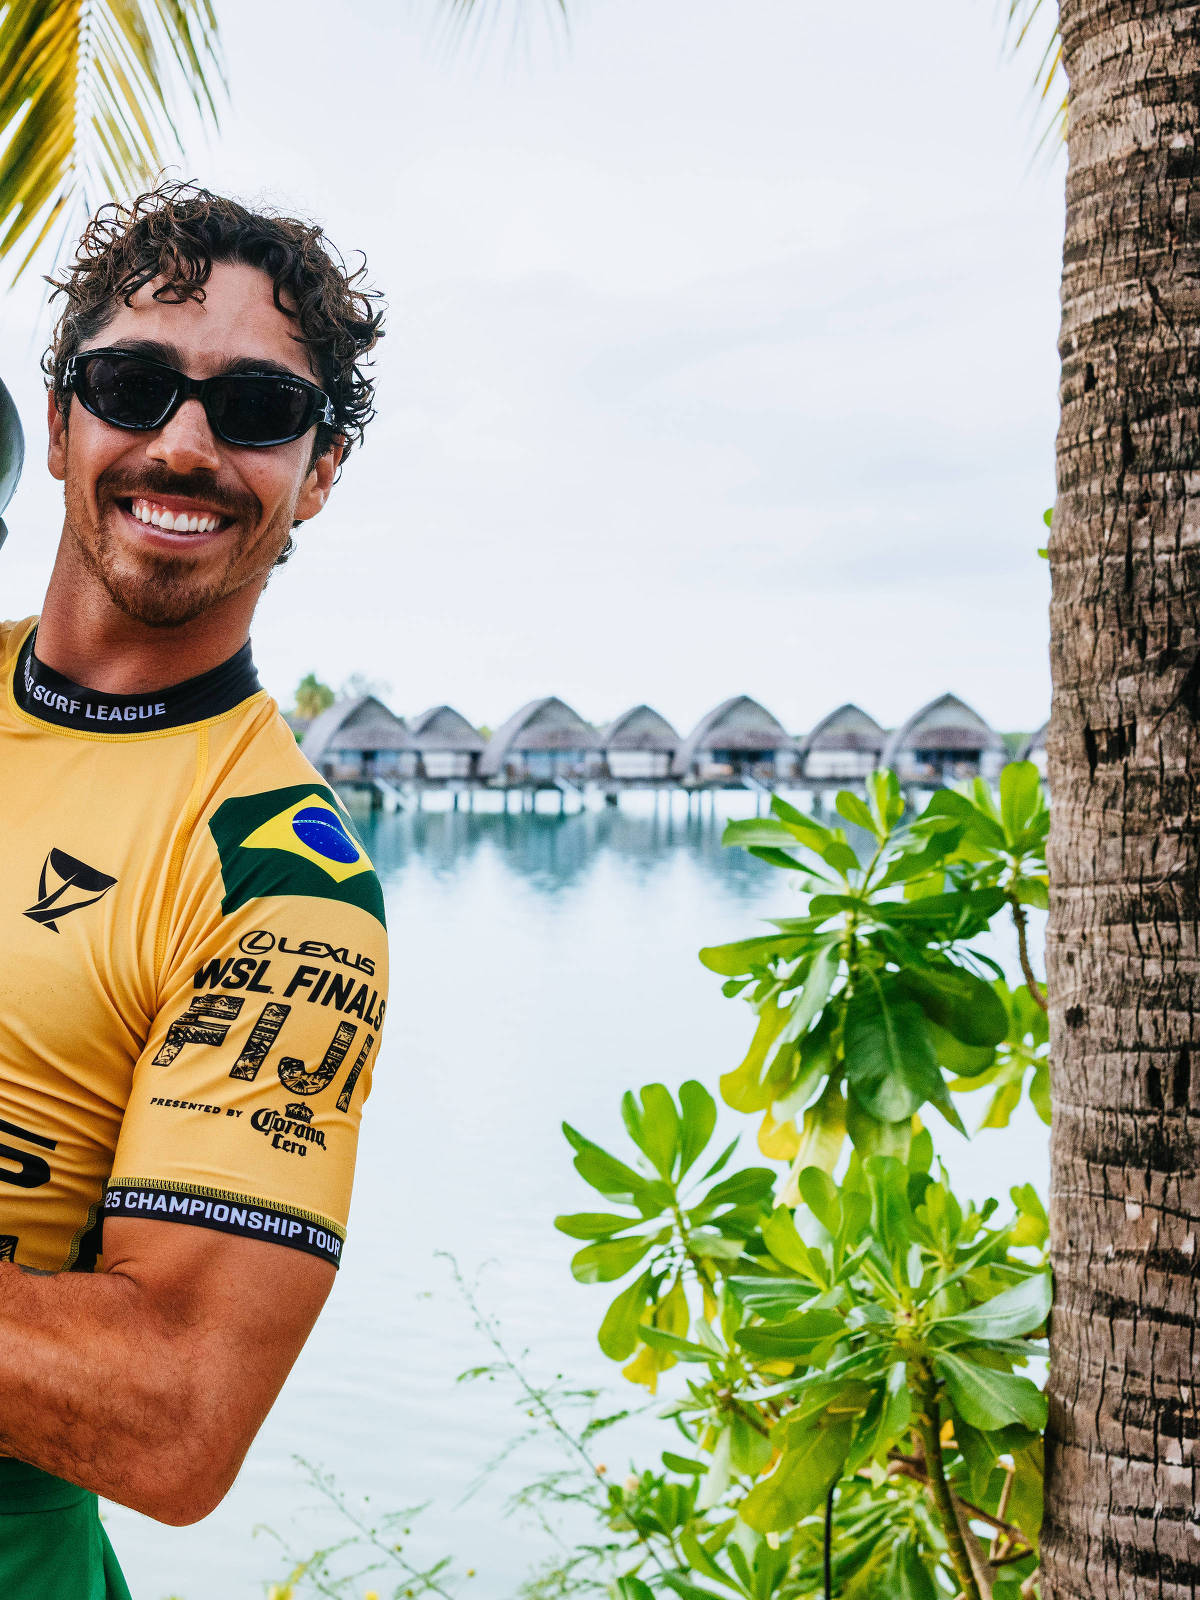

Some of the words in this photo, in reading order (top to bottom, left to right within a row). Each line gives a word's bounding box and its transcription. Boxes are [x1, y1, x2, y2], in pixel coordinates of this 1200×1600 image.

[33, 684, 81, 714] SURF
[85, 702, 166, 721] LEAGUE
[278, 936, 376, 977] LEXUS
[193, 957, 273, 994] WSL
[282, 964, 386, 1032] FINALS
[151, 993, 375, 1114] FIJI
[150, 1097, 222, 1114] PRESENTED
[226, 1108, 244, 1118] BY
[250, 1107, 327, 1151] Corona
[270, 1133, 307, 1157] Cero
[124, 1191, 302, 1238] CHAMPIONSHIP
[306, 1225, 341, 1258] TOUR
